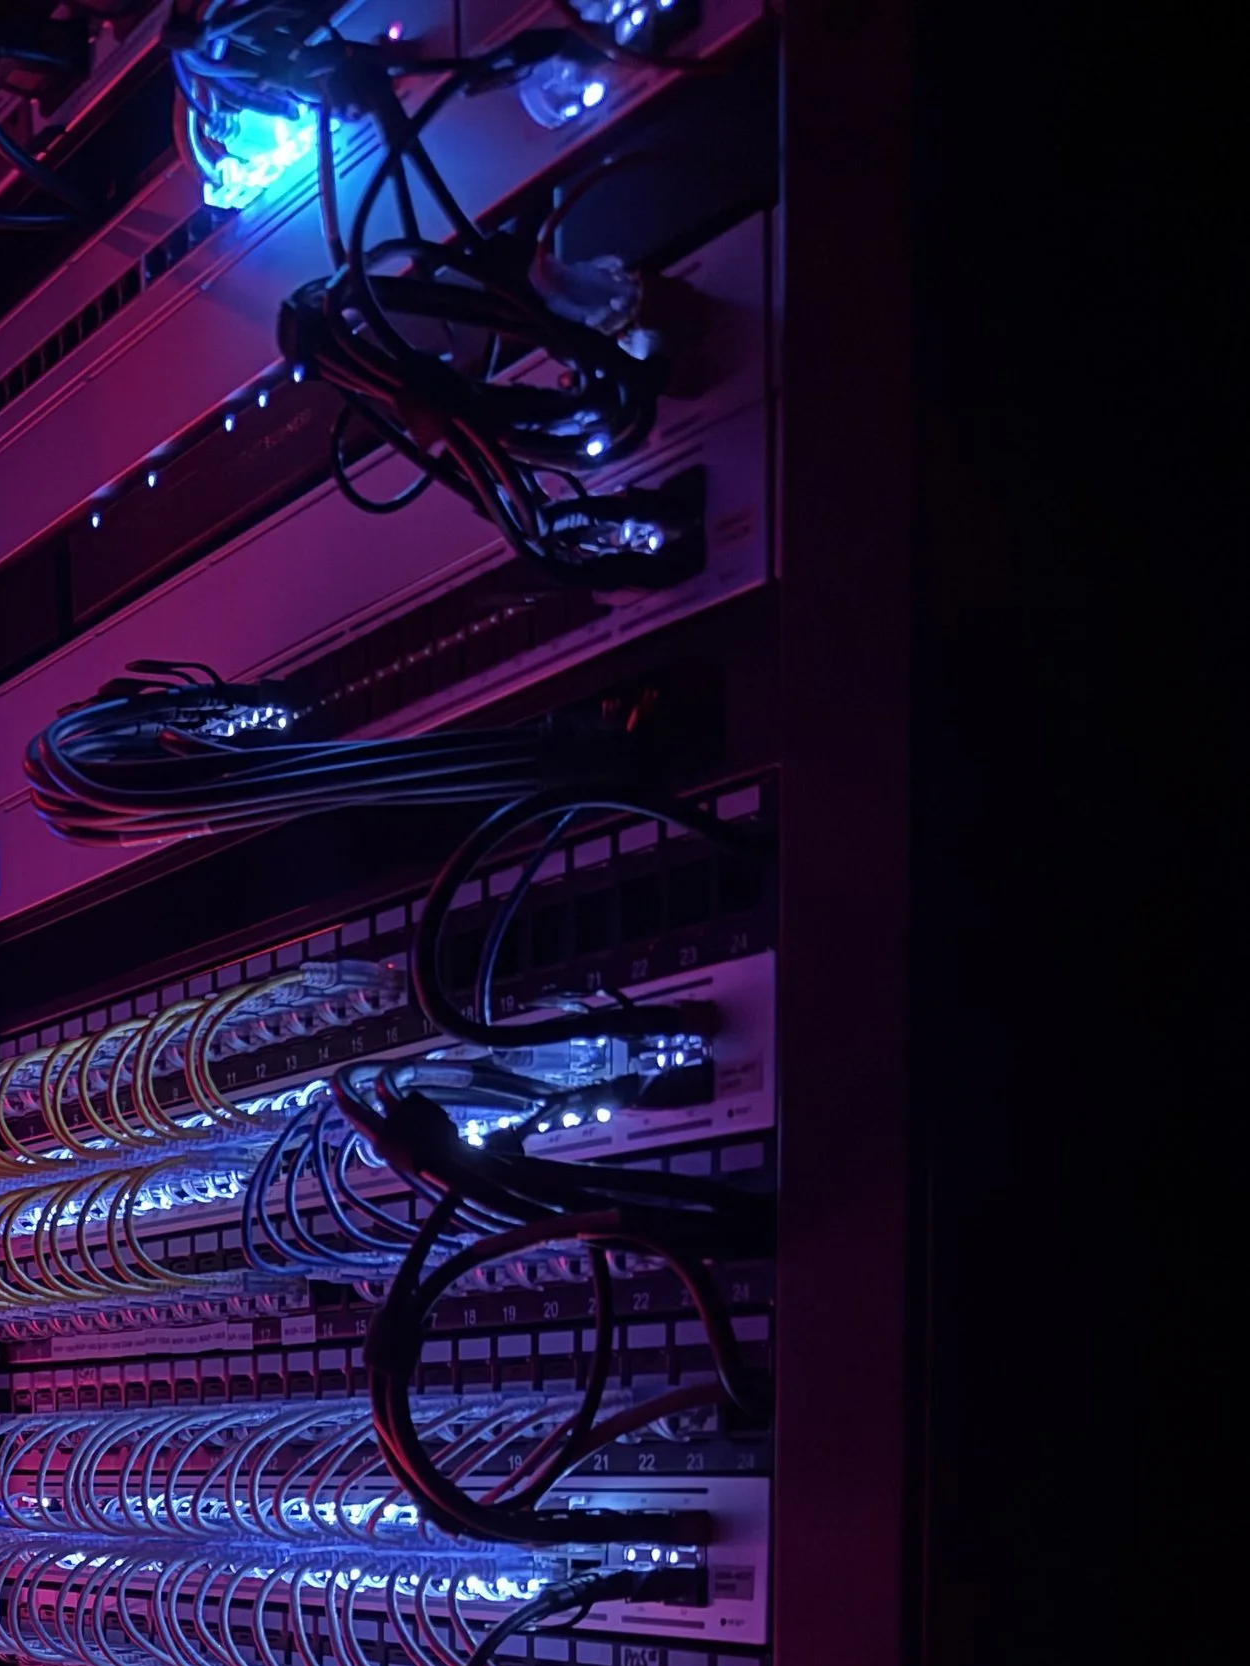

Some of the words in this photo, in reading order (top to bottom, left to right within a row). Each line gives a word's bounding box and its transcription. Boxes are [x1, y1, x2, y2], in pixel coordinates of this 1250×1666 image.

[226, 1071, 237, 1087] 11
[255, 1063, 267, 1079] 12
[285, 1054, 298, 1070] 13
[317, 1047, 330, 1063] 14
[351, 1036, 364, 1054] 15
[386, 1026, 399, 1043] 16
[679, 945, 698, 966] 23
[729, 931, 749, 954] 24
[322, 1322, 334, 1337] 14
[355, 1319, 367, 1335] 15
[431, 1312, 438, 1328] 7
[462, 1308, 476, 1325] 18
[502, 1305, 517, 1322] 19
[543, 1300, 559, 1318] 20
[587, 1297, 597, 1314] 2
[632, 1292, 650, 1311] 22
[731, 1283, 750, 1302] 24
[507, 1454, 523, 1471] 19
[593, 1454, 609, 1471] 21
[638, 1454, 656, 1471] 22
[686, 1453, 704, 1471] 23
[737, 1452, 755, 1470] 24
